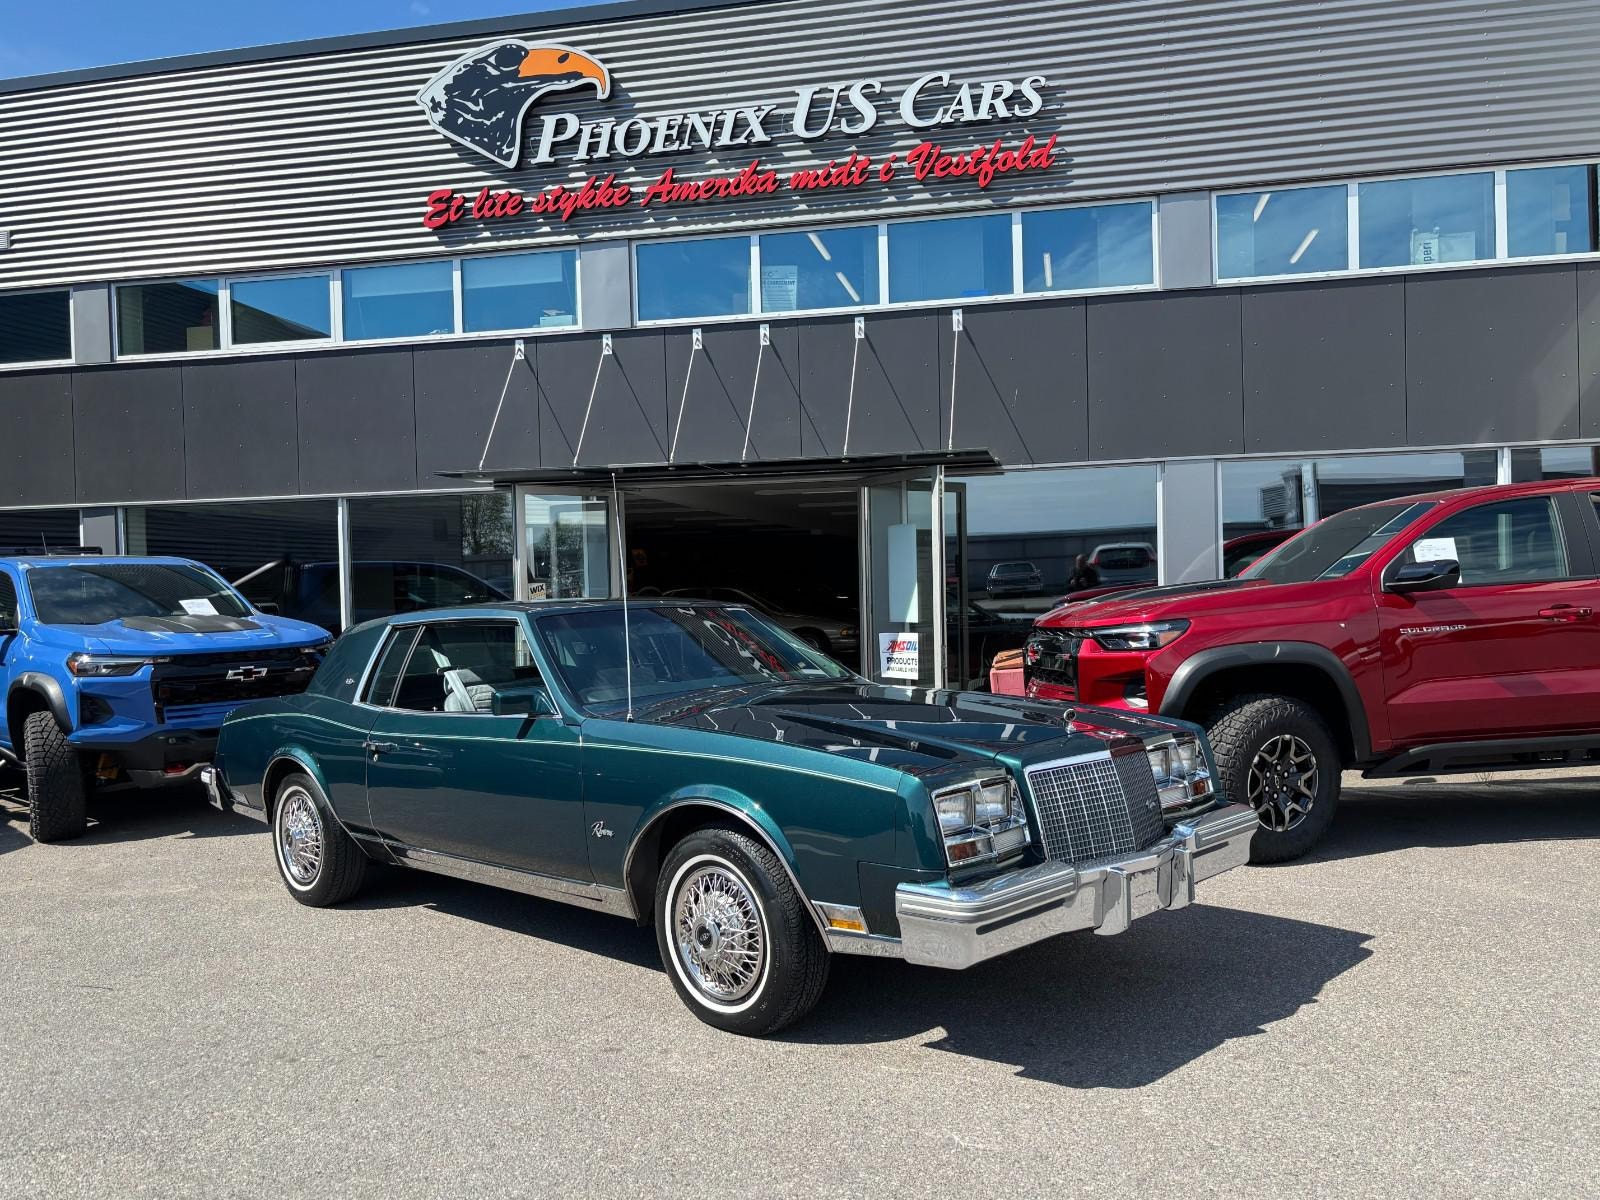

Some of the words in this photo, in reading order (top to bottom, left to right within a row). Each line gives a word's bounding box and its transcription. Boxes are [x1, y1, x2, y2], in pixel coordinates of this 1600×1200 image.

[531, 105, 776, 164] PHOENIX
[792, 79, 882, 139] US
[900, 71, 1046, 128] CARS
[423, 188, 464, 229] Et
[472, 187, 522, 219] lite
[531, 173, 630, 221] stykke
[641, 160, 779, 206] Amerika
[790, 153, 870, 190] midt
[879, 155, 897, 182] i
[906, 134, 1057, 188] Vestfold
[530, 584, 545, 594] WIX
[886, 656, 918, 666] PRODUCTS
